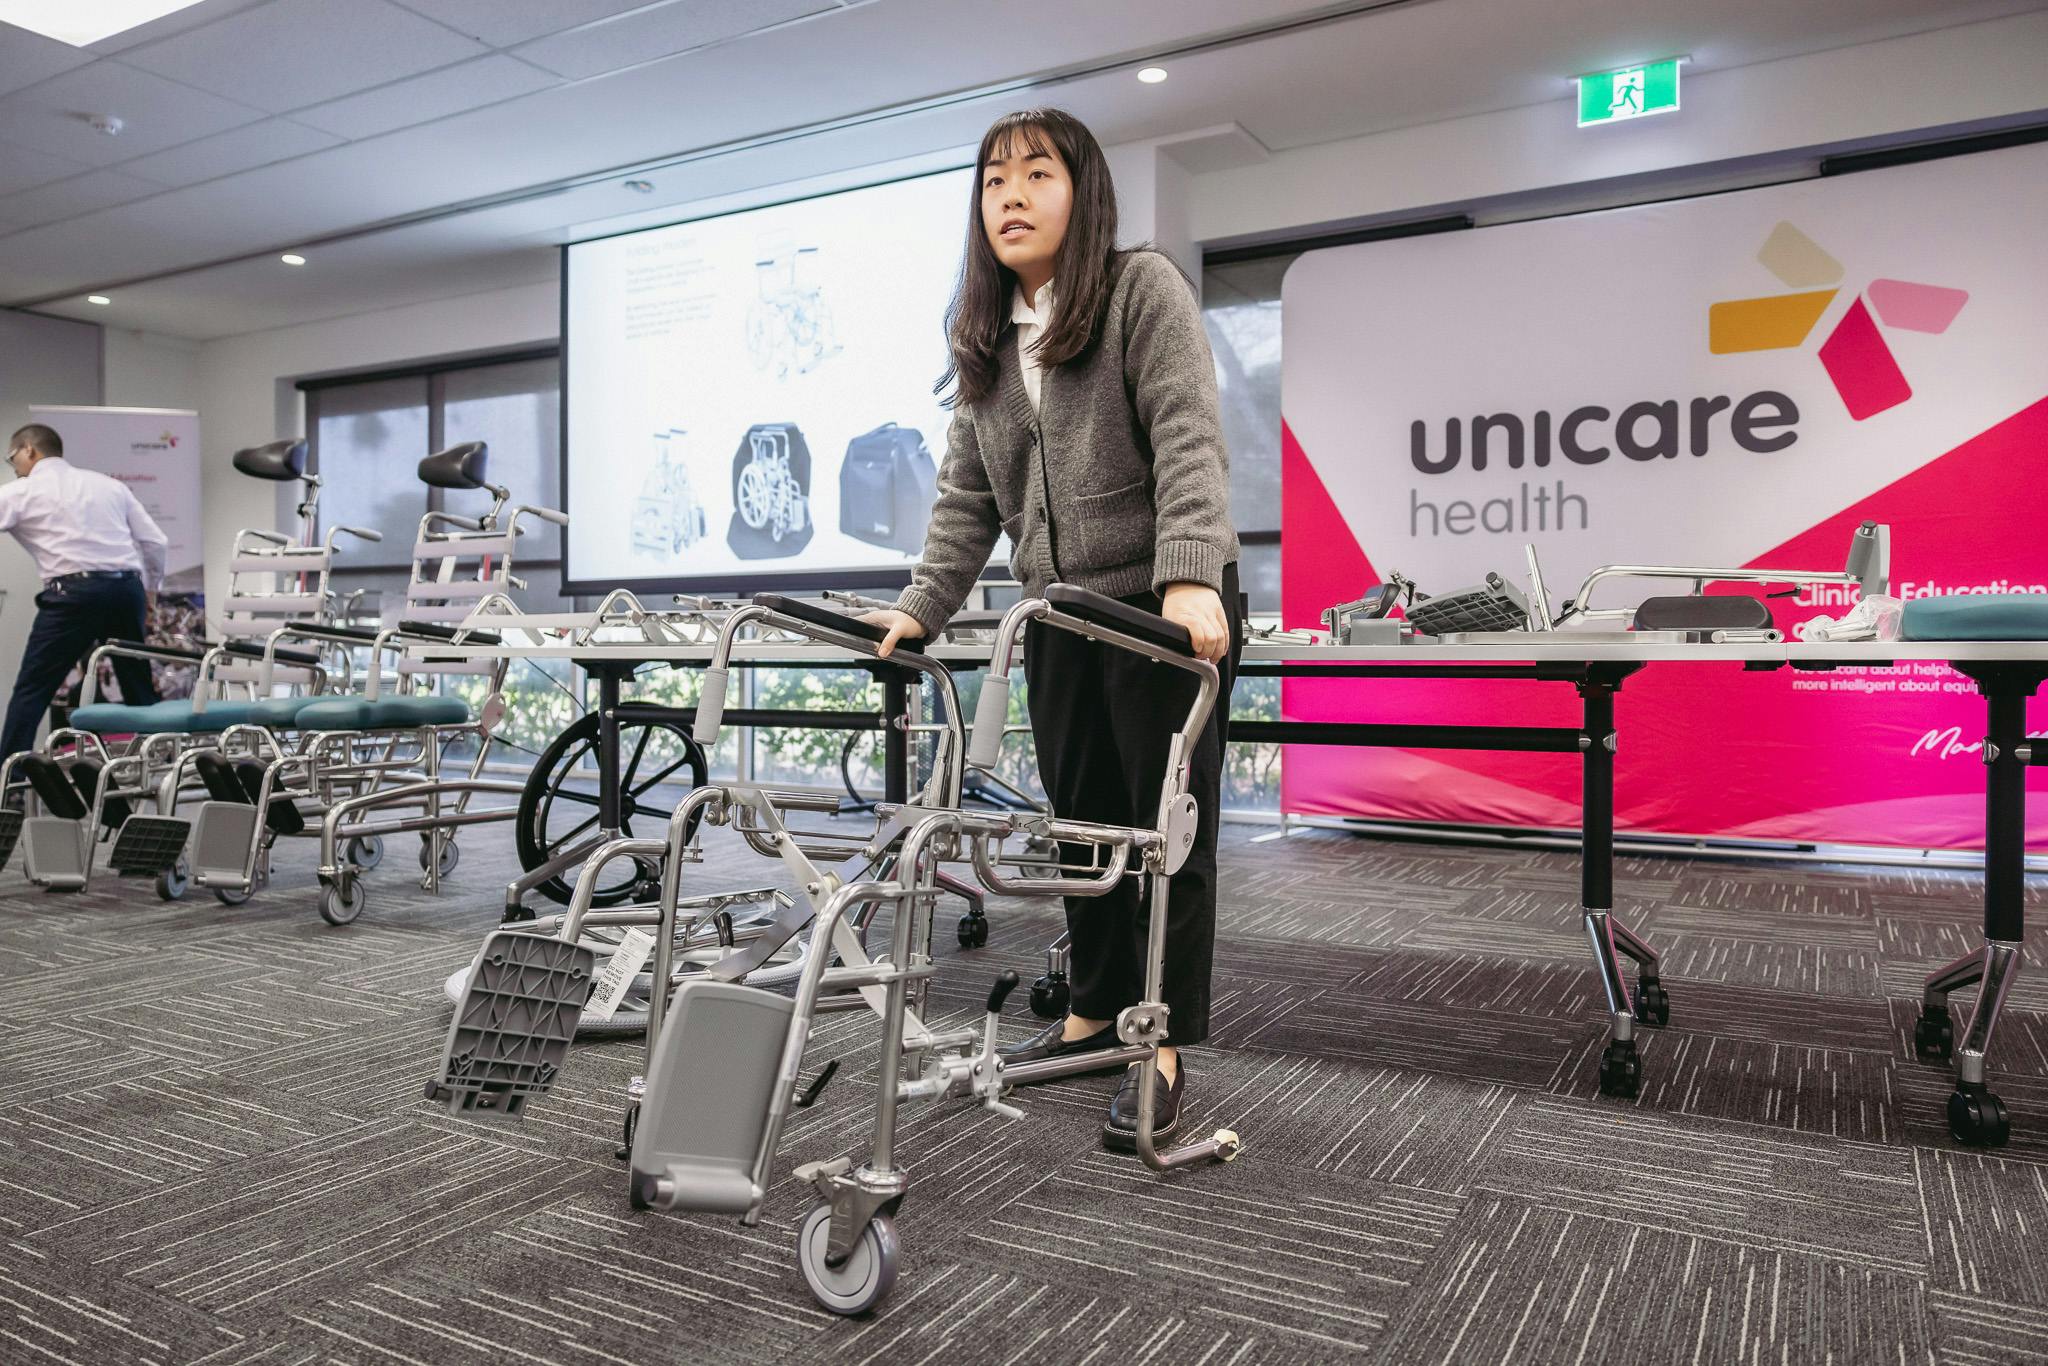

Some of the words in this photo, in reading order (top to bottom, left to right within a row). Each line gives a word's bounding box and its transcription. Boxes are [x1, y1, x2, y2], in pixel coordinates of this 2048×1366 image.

[1410, 390, 1800, 475] unicare
[1410, 480, 1589, 537] health
[1792, 680, 1828, 691] more
[1830, 678, 1895, 694] intelligent
[1898, 679, 1940, 692] about
